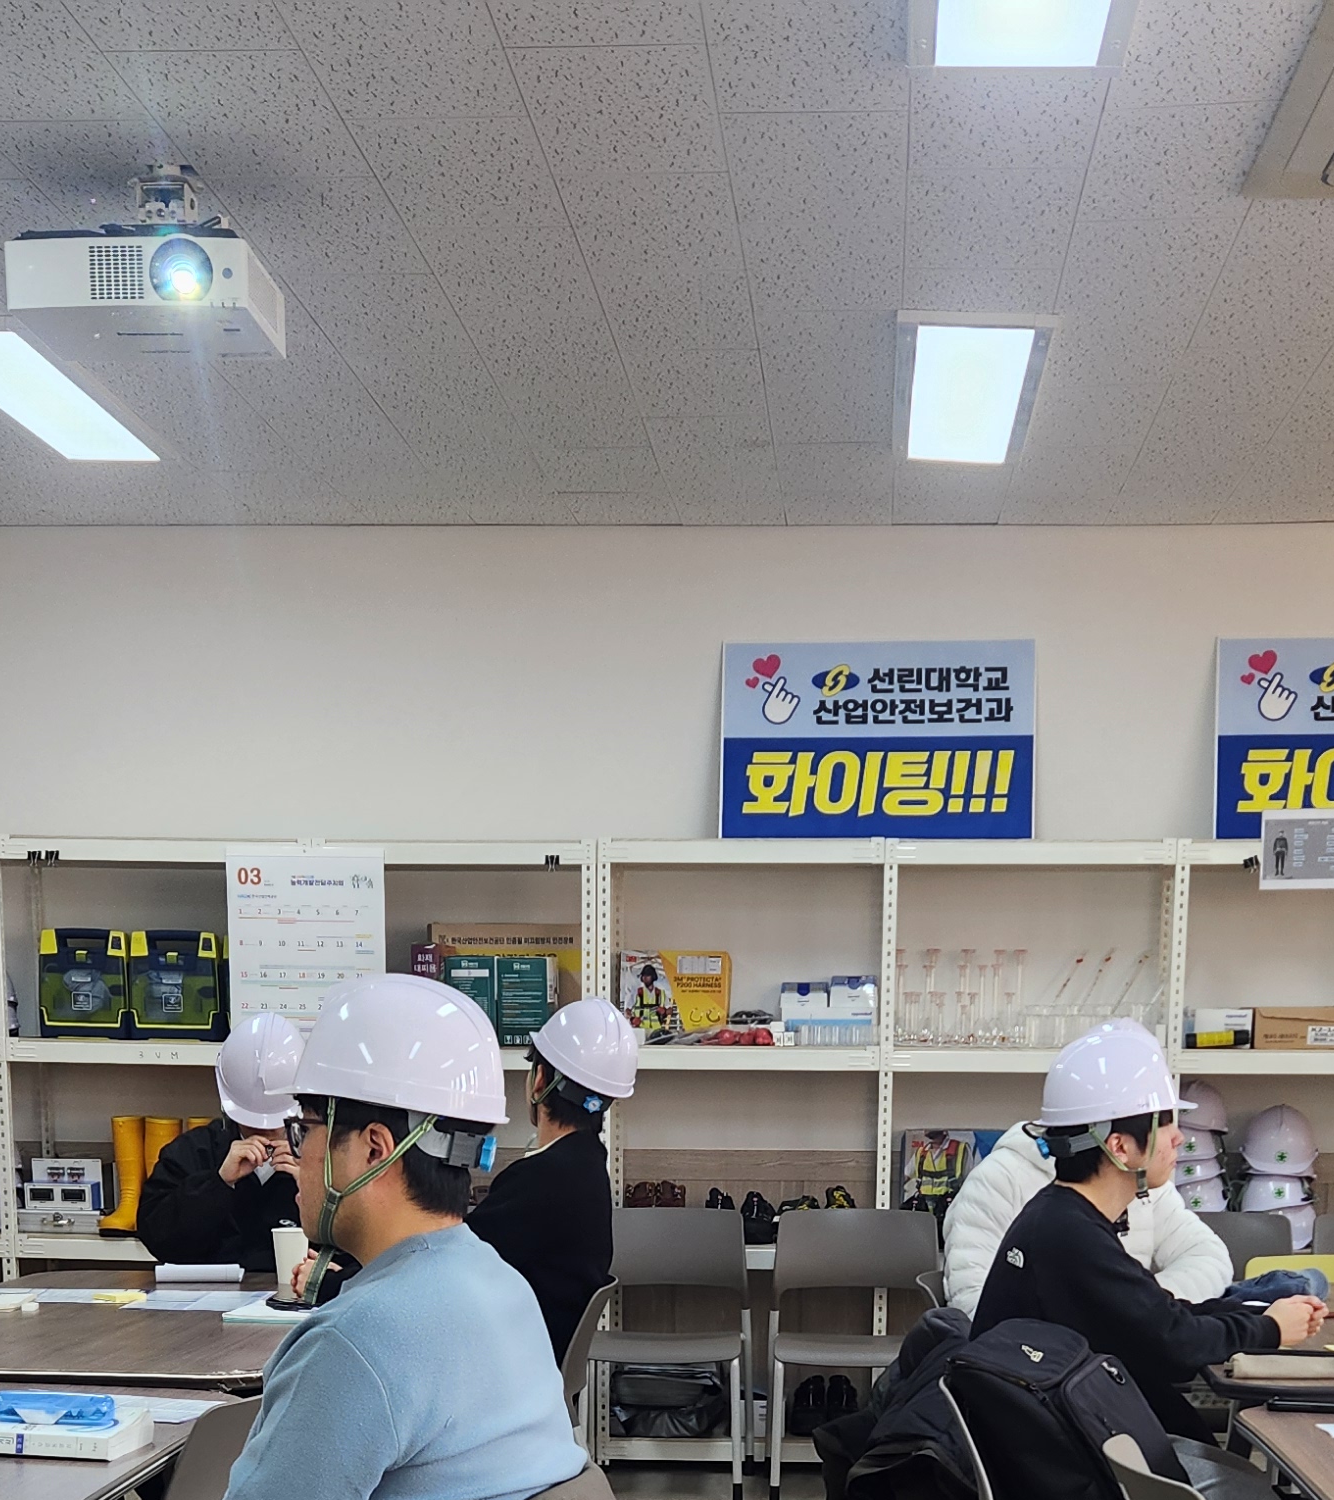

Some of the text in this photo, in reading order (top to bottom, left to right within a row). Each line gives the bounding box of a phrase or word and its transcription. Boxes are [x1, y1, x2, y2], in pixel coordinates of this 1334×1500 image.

[867, 666, 1010, 694] 선린대학교
[812, 695, 1014, 725] 산업안전보건과
[743, 751, 1015, 816] 화이팅!!!
[237, 867, 262, 886] 03
[414, 963, 438, 973] 대피용
[417, 953, 433, 962] 화재
